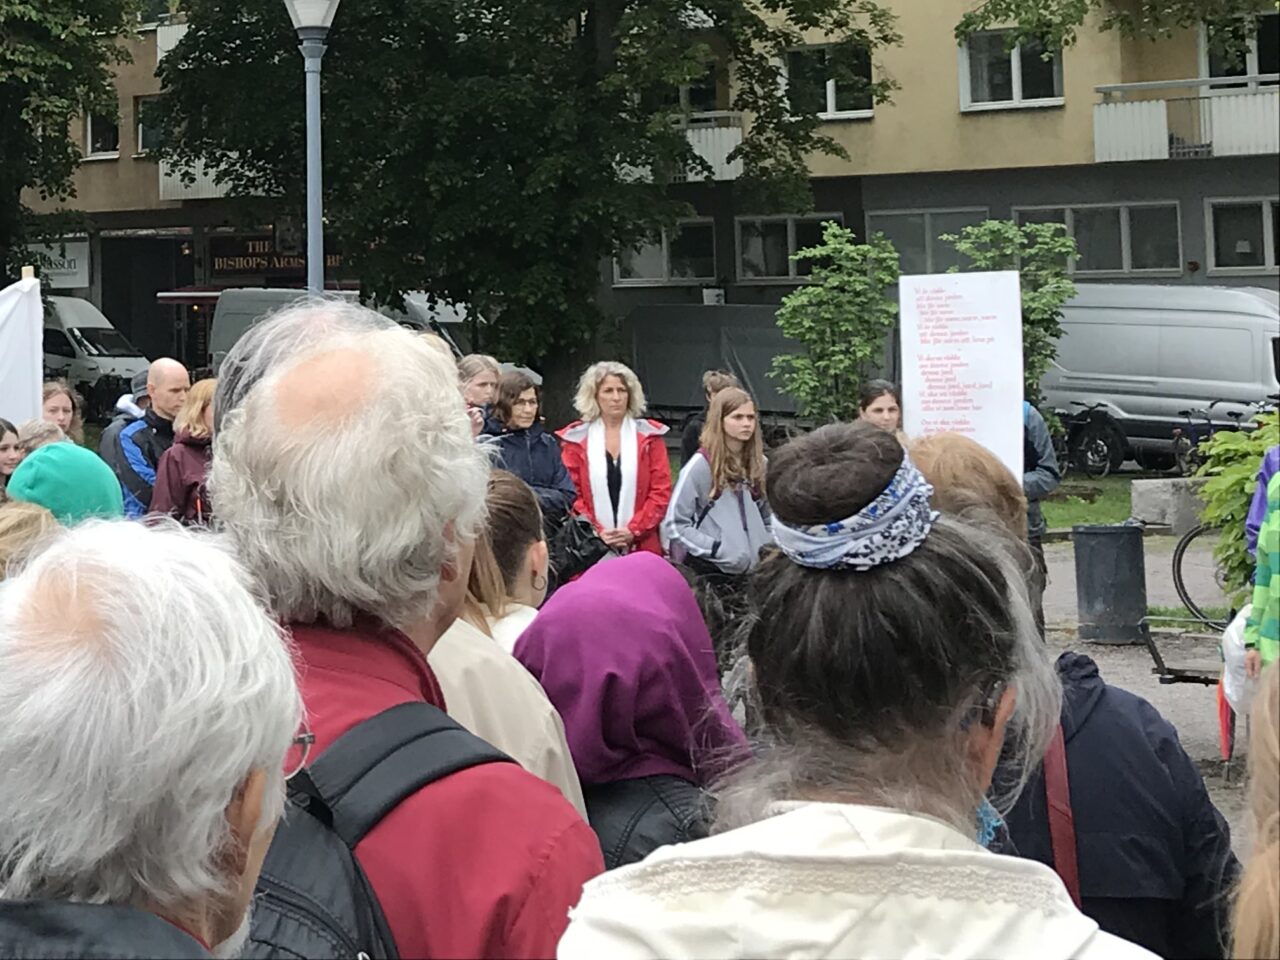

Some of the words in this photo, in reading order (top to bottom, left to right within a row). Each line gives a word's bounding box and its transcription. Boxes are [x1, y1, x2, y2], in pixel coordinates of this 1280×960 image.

[247, 240, 273, 253] THE
[214, 256, 268, 270] BISHOPS
[271, 256, 306, 269] ARMS
